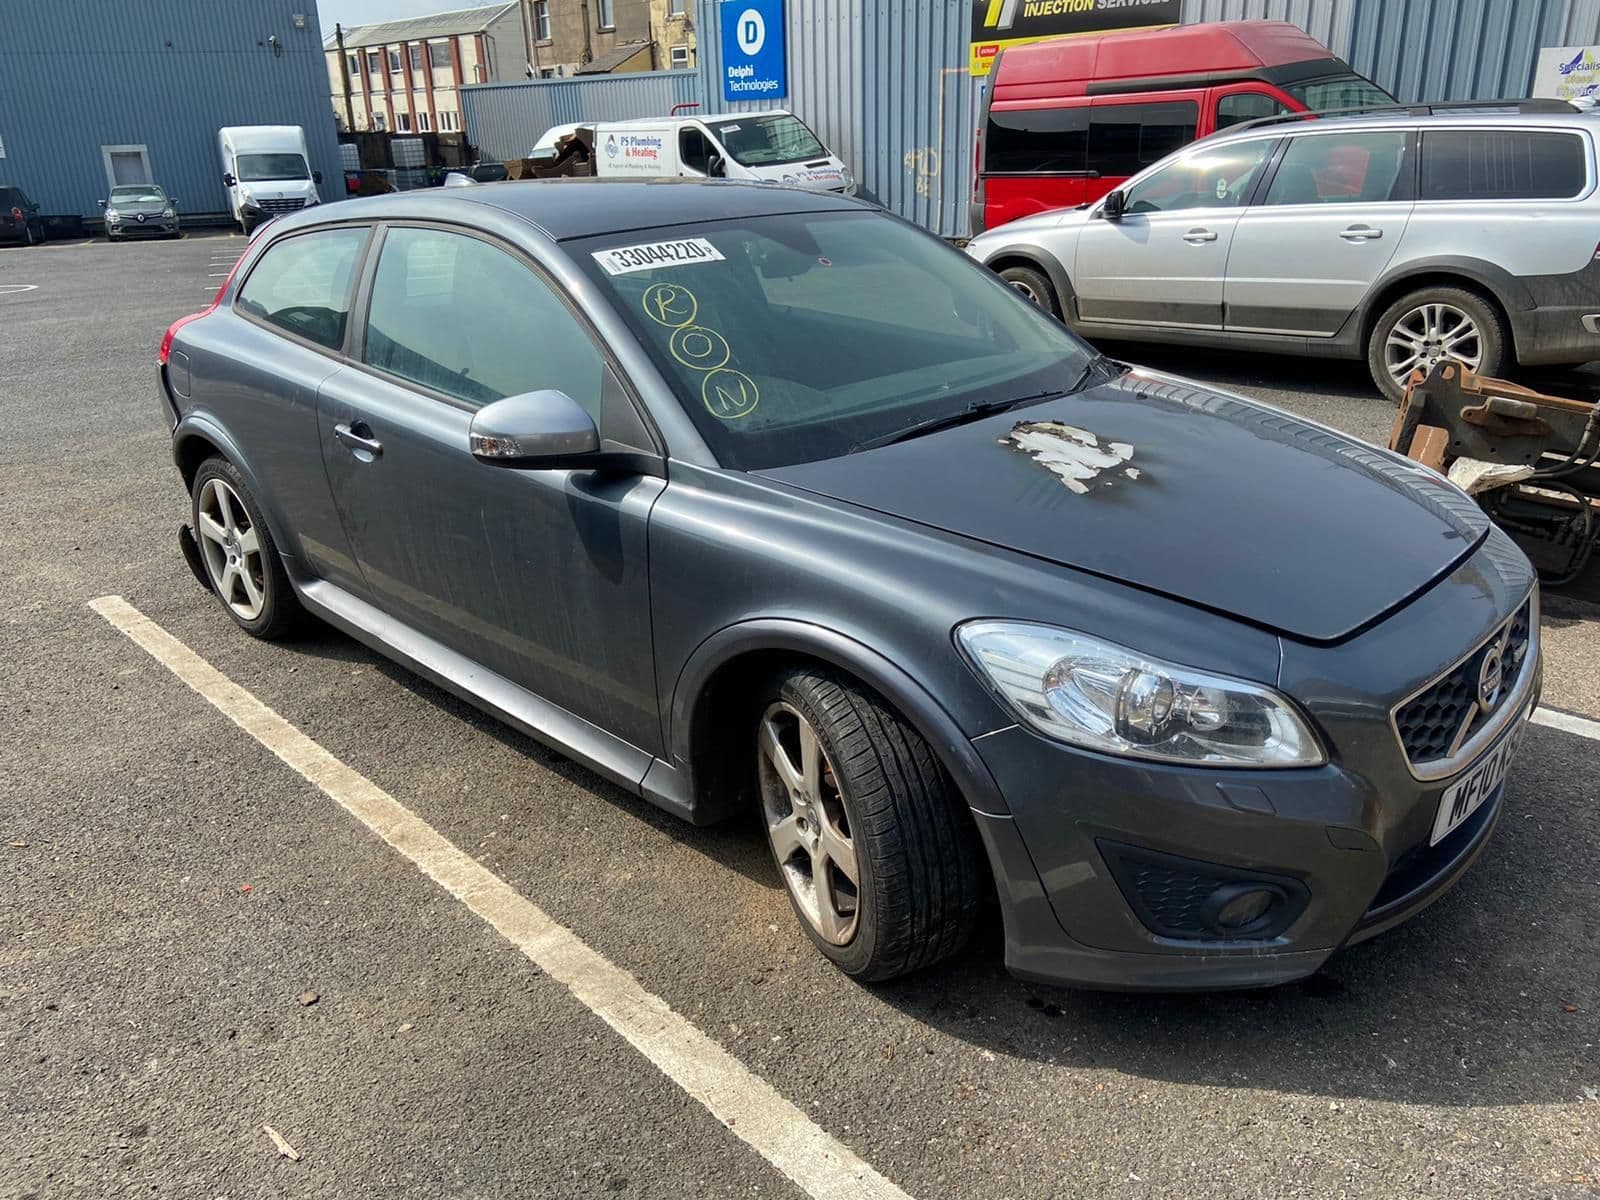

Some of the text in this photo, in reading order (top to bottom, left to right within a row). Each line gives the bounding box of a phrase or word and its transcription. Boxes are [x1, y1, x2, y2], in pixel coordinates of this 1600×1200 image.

[1024, 0, 1094, 17] INJECTION
[745, 21, 757, 44] D
[728, 65, 754, 79] Delphi
[1559, 61, 1600, 73] Specialis
[729, 78, 779, 92] Technologies
[621, 136, 629, 145] PS
[630, 136, 662, 149] Plumbing
[632, 147, 657, 160] Heating
[611, 241, 706, 267] 33044220
[1448, 752, 1499, 827] MF10
